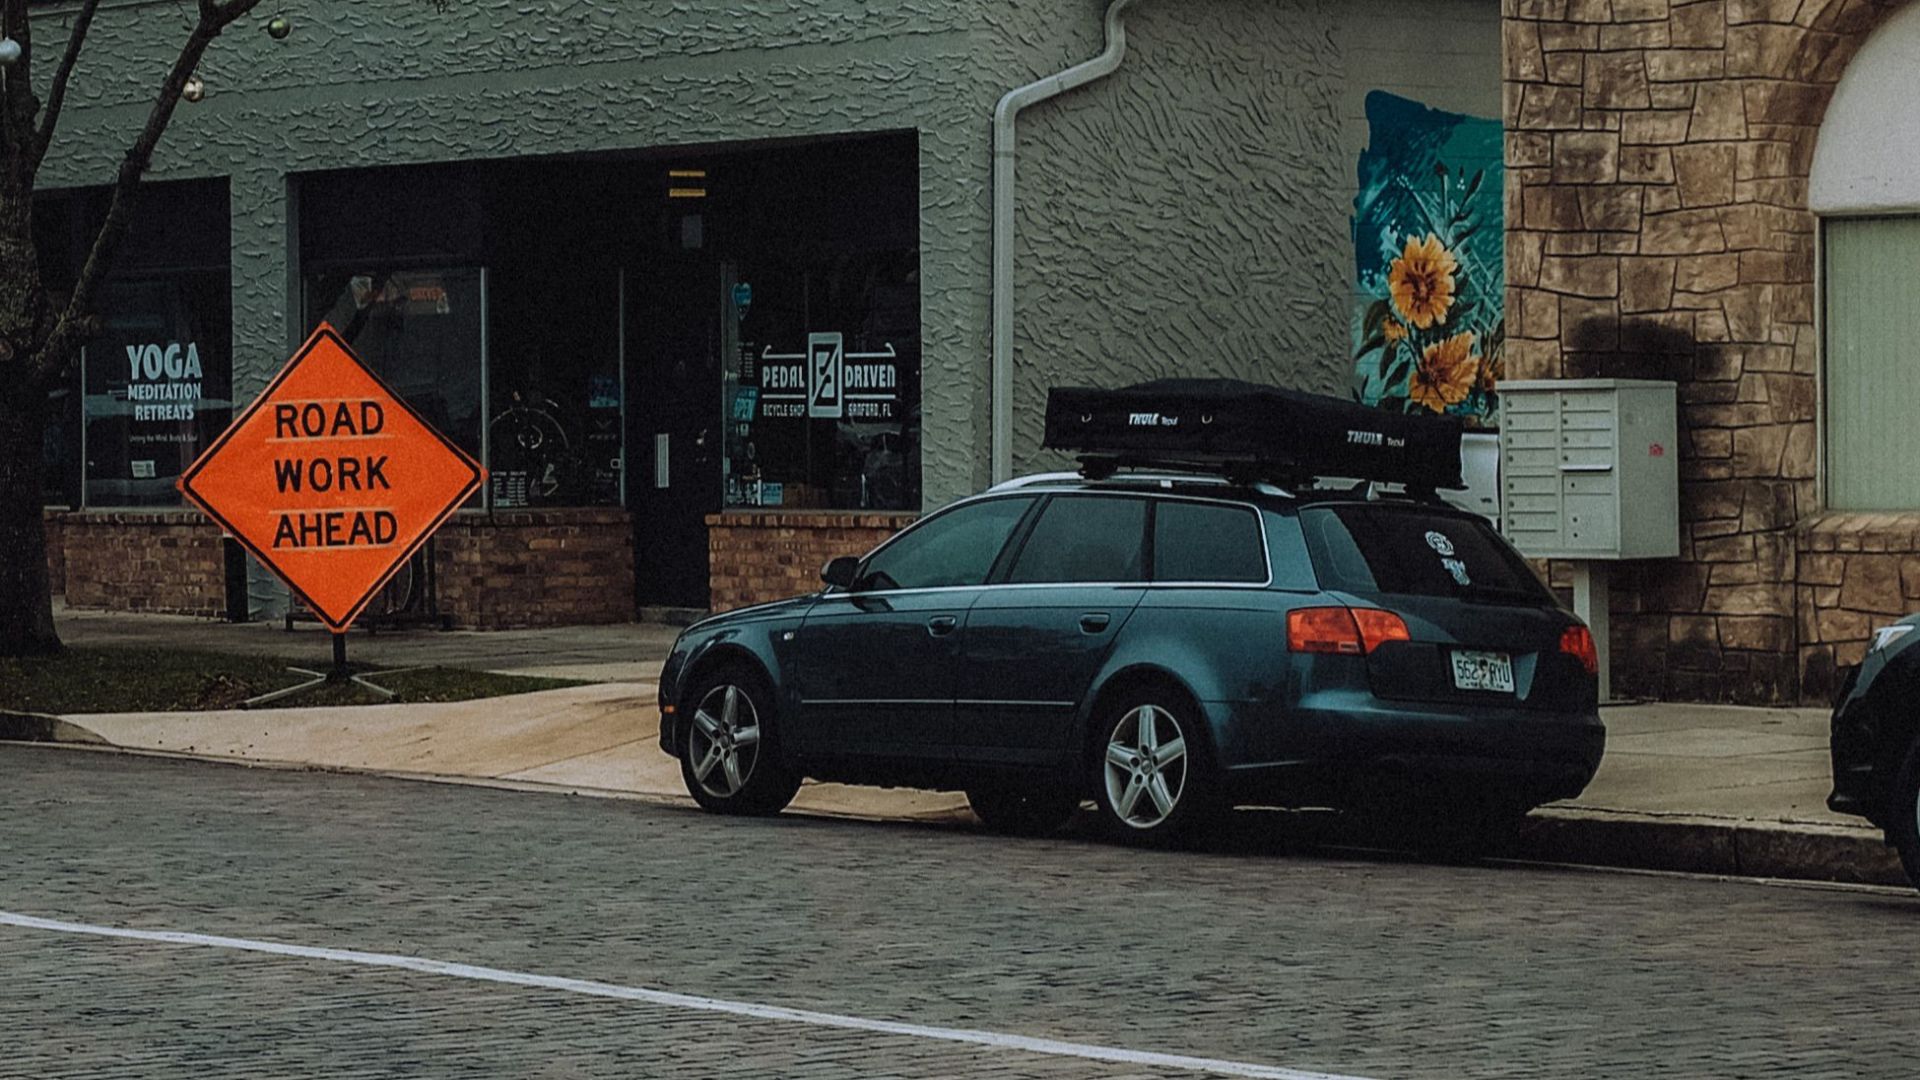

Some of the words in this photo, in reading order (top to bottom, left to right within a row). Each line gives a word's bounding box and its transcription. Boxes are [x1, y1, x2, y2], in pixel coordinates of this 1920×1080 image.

[126, 342, 203, 380] YOGA
[762, 365, 805, 388] PEDAL
[844, 364, 896, 388] DRIVEN
[127, 382, 201, 401] MEDITATION
[134, 403, 195, 422] RETREATS
[275, 401, 385, 438] ROAD
[763, 403, 788, 417] BICYCLE
[789, 403, 805, 417] SHOP
[882, 403, 892, 417] FL
[1129, 412, 1160, 426] THULE
[1347, 429, 1384, 446] THULE
[274, 455, 391, 493] WORK
[272, 511, 398, 548] AHEAD
[1456, 659, 1480, 681] 562
